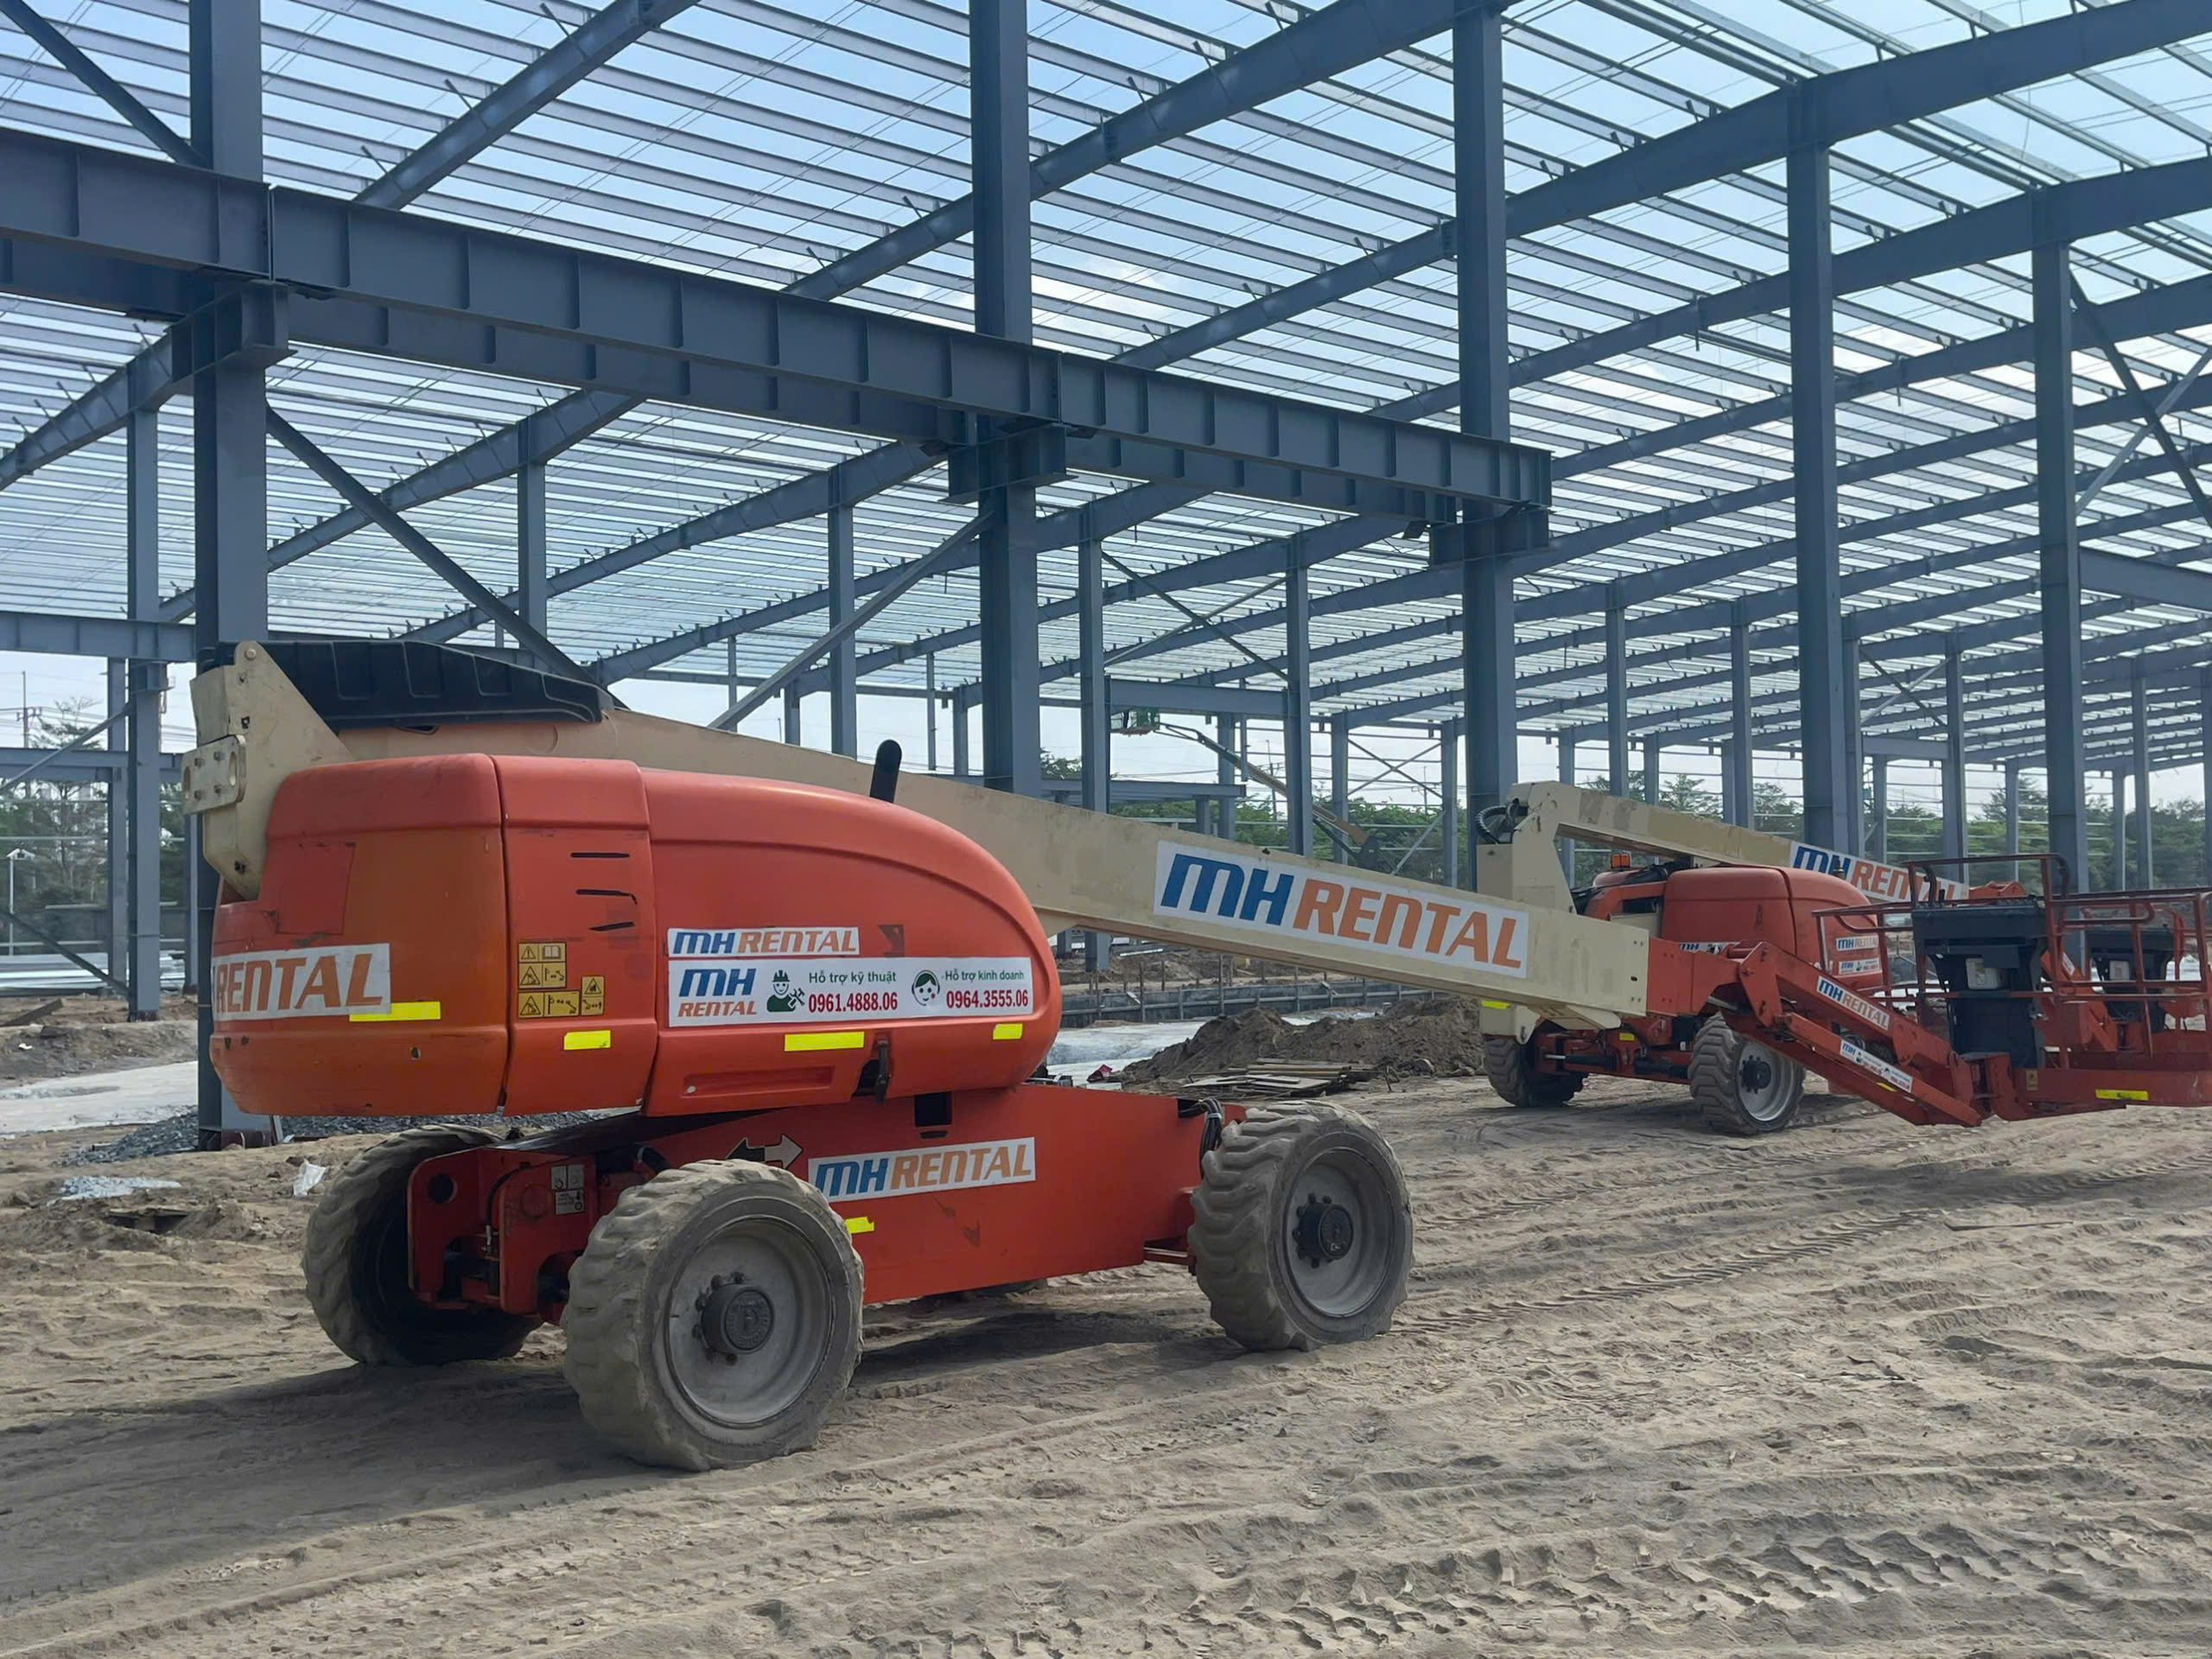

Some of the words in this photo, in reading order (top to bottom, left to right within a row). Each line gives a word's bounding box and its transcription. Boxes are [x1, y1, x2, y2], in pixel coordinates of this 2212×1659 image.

[1160, 854, 1294, 925] MH
[1293, 879, 1521, 969] RENTAL
[673, 931, 735, 954] MH
[737, 931, 856, 953] RENTAL
[217, 954, 383, 1013] RENTAL
[678, 969, 757, 997] MH
[809, 969, 826, 983] Hỗ
[830, 974, 848, 985] trợ
[851, 971, 864, 985] kỹ
[868, 970, 897, 984] thuật
[945, 968, 959, 981] Hỗ
[962, 971, 976, 983] trợ
[978, 969, 997, 981] kinh
[999, 969, 1024, 981] doanh
[677, 1000, 757, 1018] RENTAL
[809, 992, 898, 1013] 0961.4888.06
[946, 989, 1028, 1008] 0964.3555.06
[1819, 979, 1843, 1001] MH
[1842, 992, 1888, 1028] RENTAL
[815, 1158, 889, 1198] MH
[890, 1144, 1032, 1190] RENTAL
